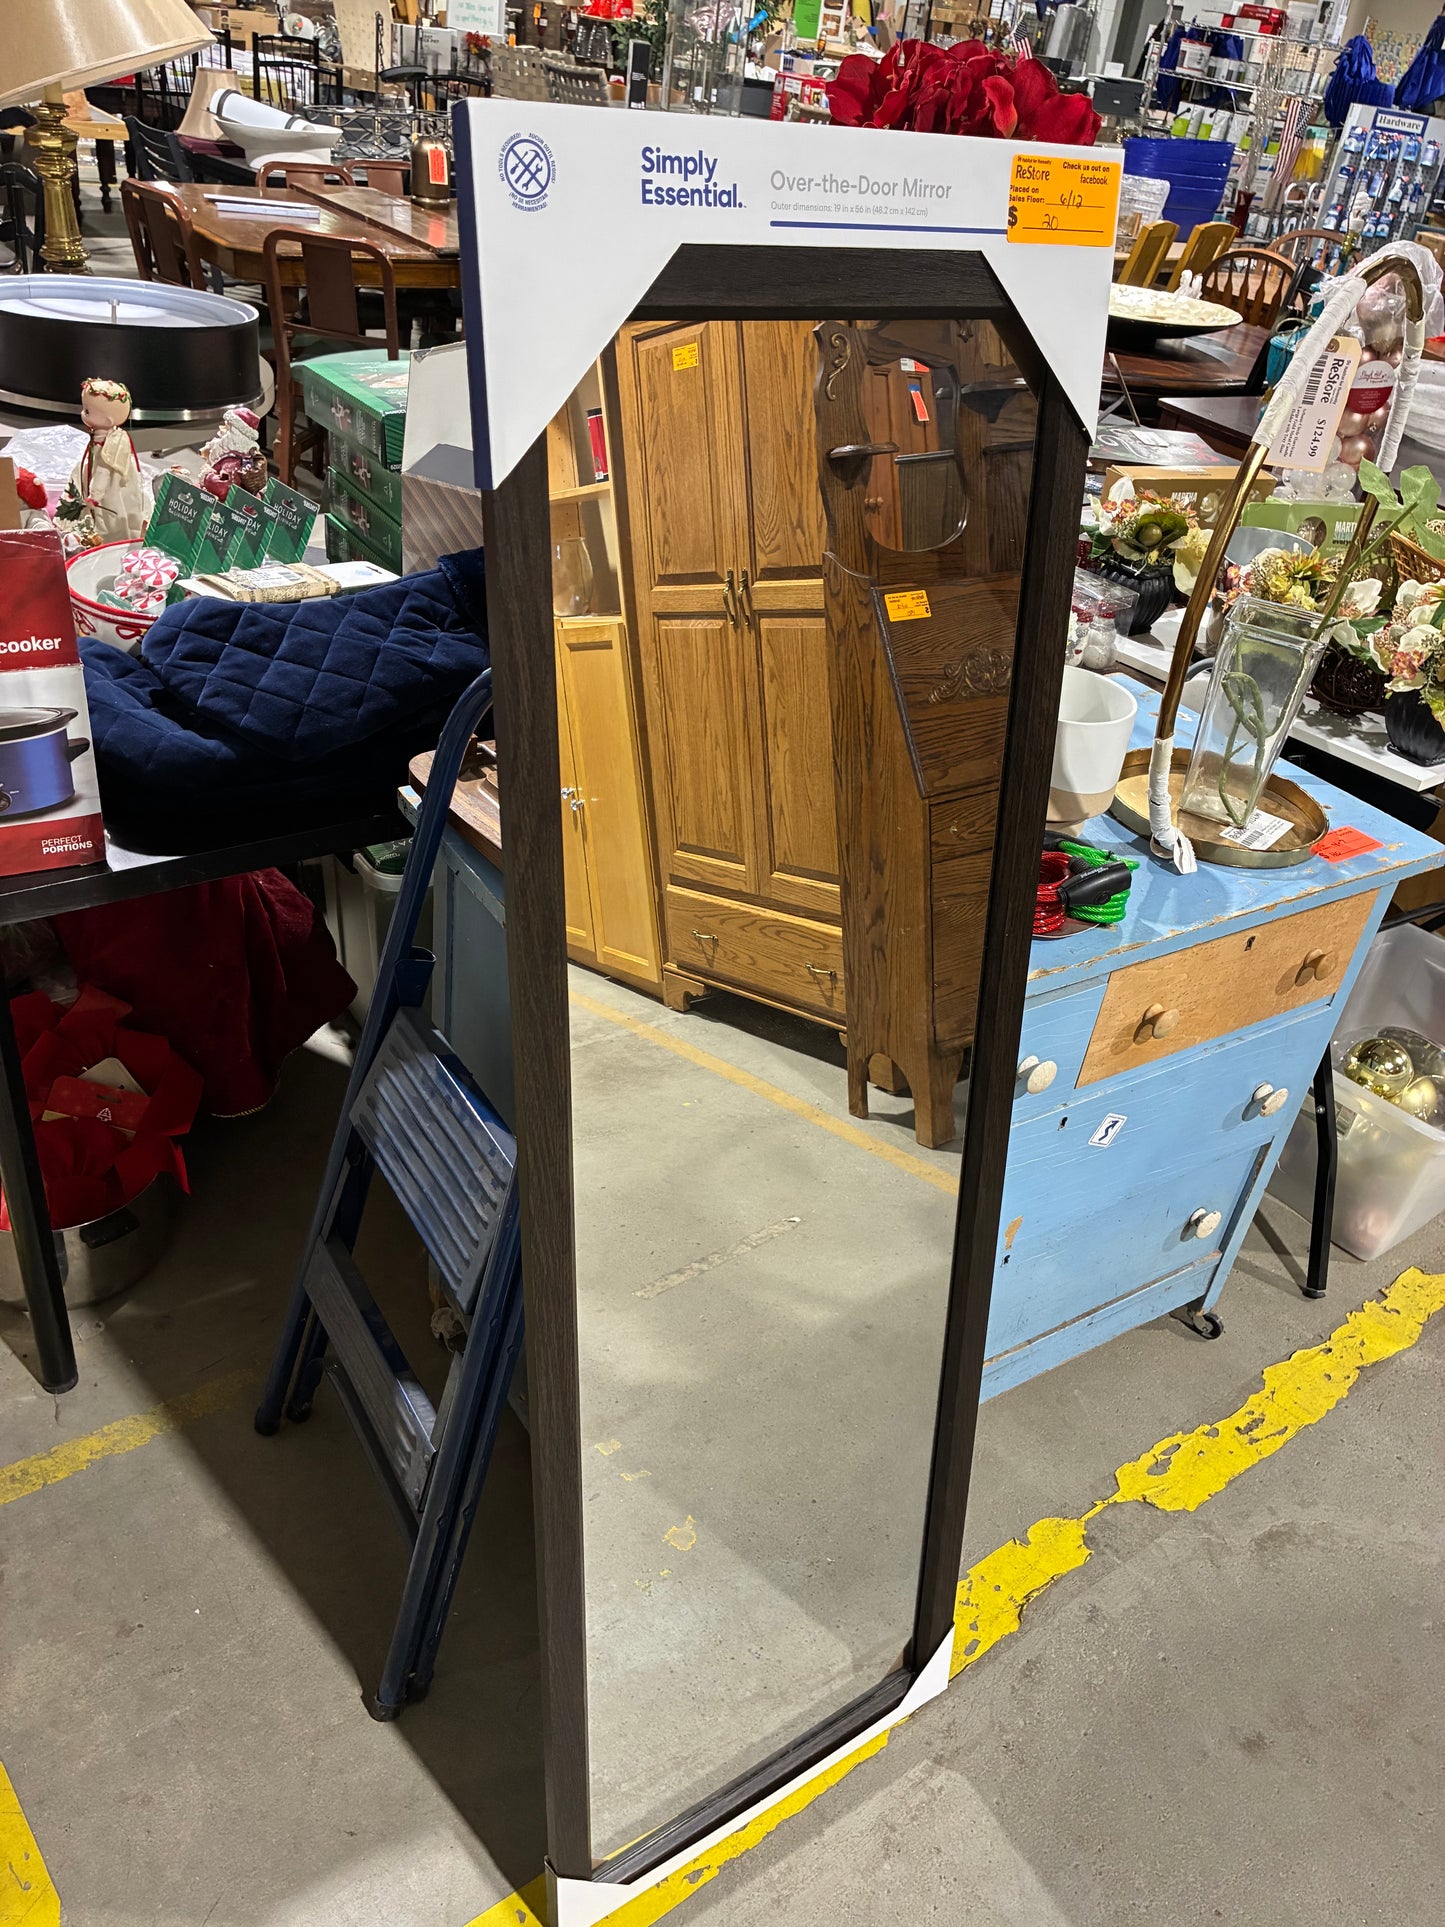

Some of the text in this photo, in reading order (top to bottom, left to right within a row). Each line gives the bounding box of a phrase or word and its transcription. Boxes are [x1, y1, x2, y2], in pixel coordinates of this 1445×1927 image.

[1379, 115, 1421, 130] Hardware
[641, 146, 718, 183] Simply
[1016, 165, 1050, 181] ReStore
[1062, 161, 1081, 170] Check
[770, 170, 952, 199] Over-the-Door Mirror
[1080, 174, 1108, 185] facebook
[641, 179, 743, 208] Essential.
[1026, 196, 1045, 204] Floor:
[771, 201, 791, 210] Outer
[792, 202, 833, 212] dimensions:
[834, 203, 841, 213] 19
[842, 204, 849, 212] in
[865, 205, 871, 214] in
[905, 206, 916, 216] 142
[916, 207, 928, 218] cm)
[1008, 205, 1059, 231] $ 20
[1321, 358, 1345, 404] ReStore
[169, 499, 198, 518] HOLIDAY
[273, 503, 301, 525] HOLIDAY
[208, 520, 228, 538] LIDAY
[0, 636, 62, 653] cooker
[42, 835, 82, 848] PERFECT
[42, 840, 93, 854] PORTIONS
